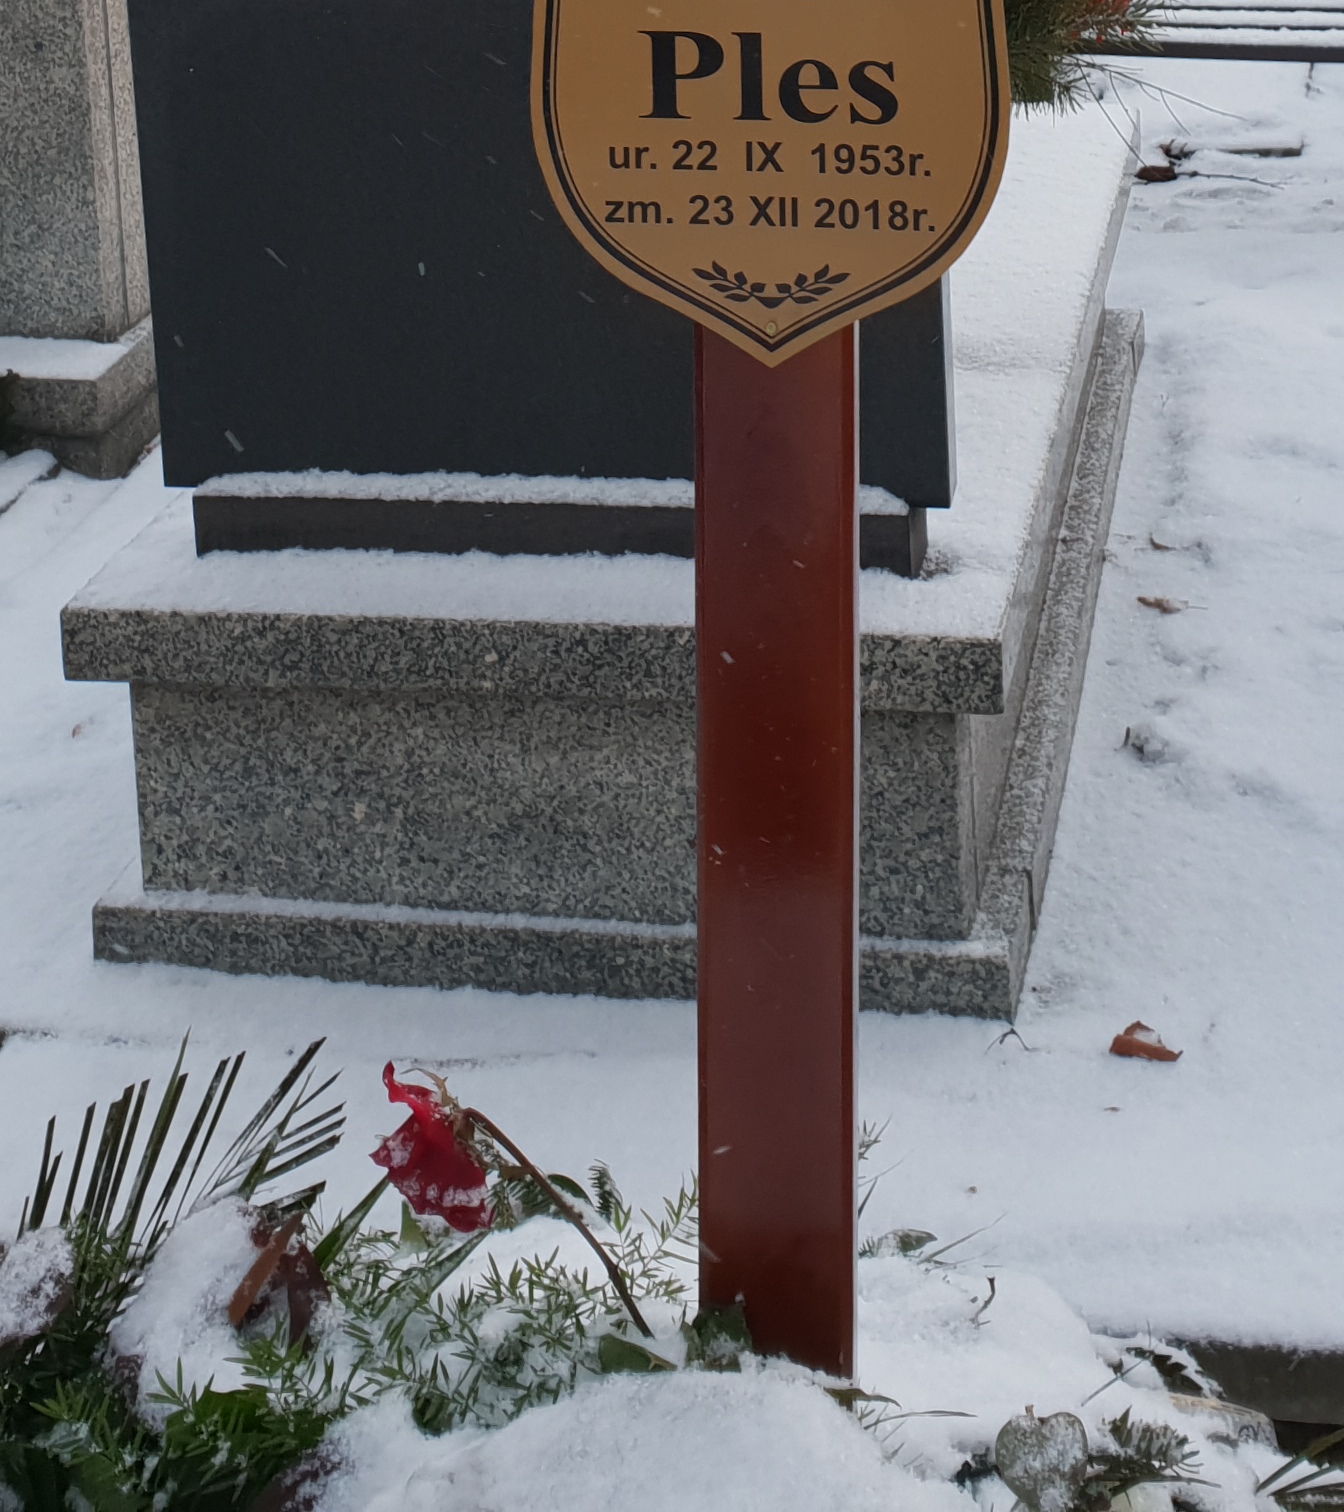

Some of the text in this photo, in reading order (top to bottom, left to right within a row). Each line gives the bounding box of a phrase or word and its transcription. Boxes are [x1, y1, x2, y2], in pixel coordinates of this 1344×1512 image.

[636, 30, 899, 126] Ples
[608, 139, 932, 177] ur. 22 IX 1953r.
[604, 194, 936, 233] zm. 23 XII 2018r.
